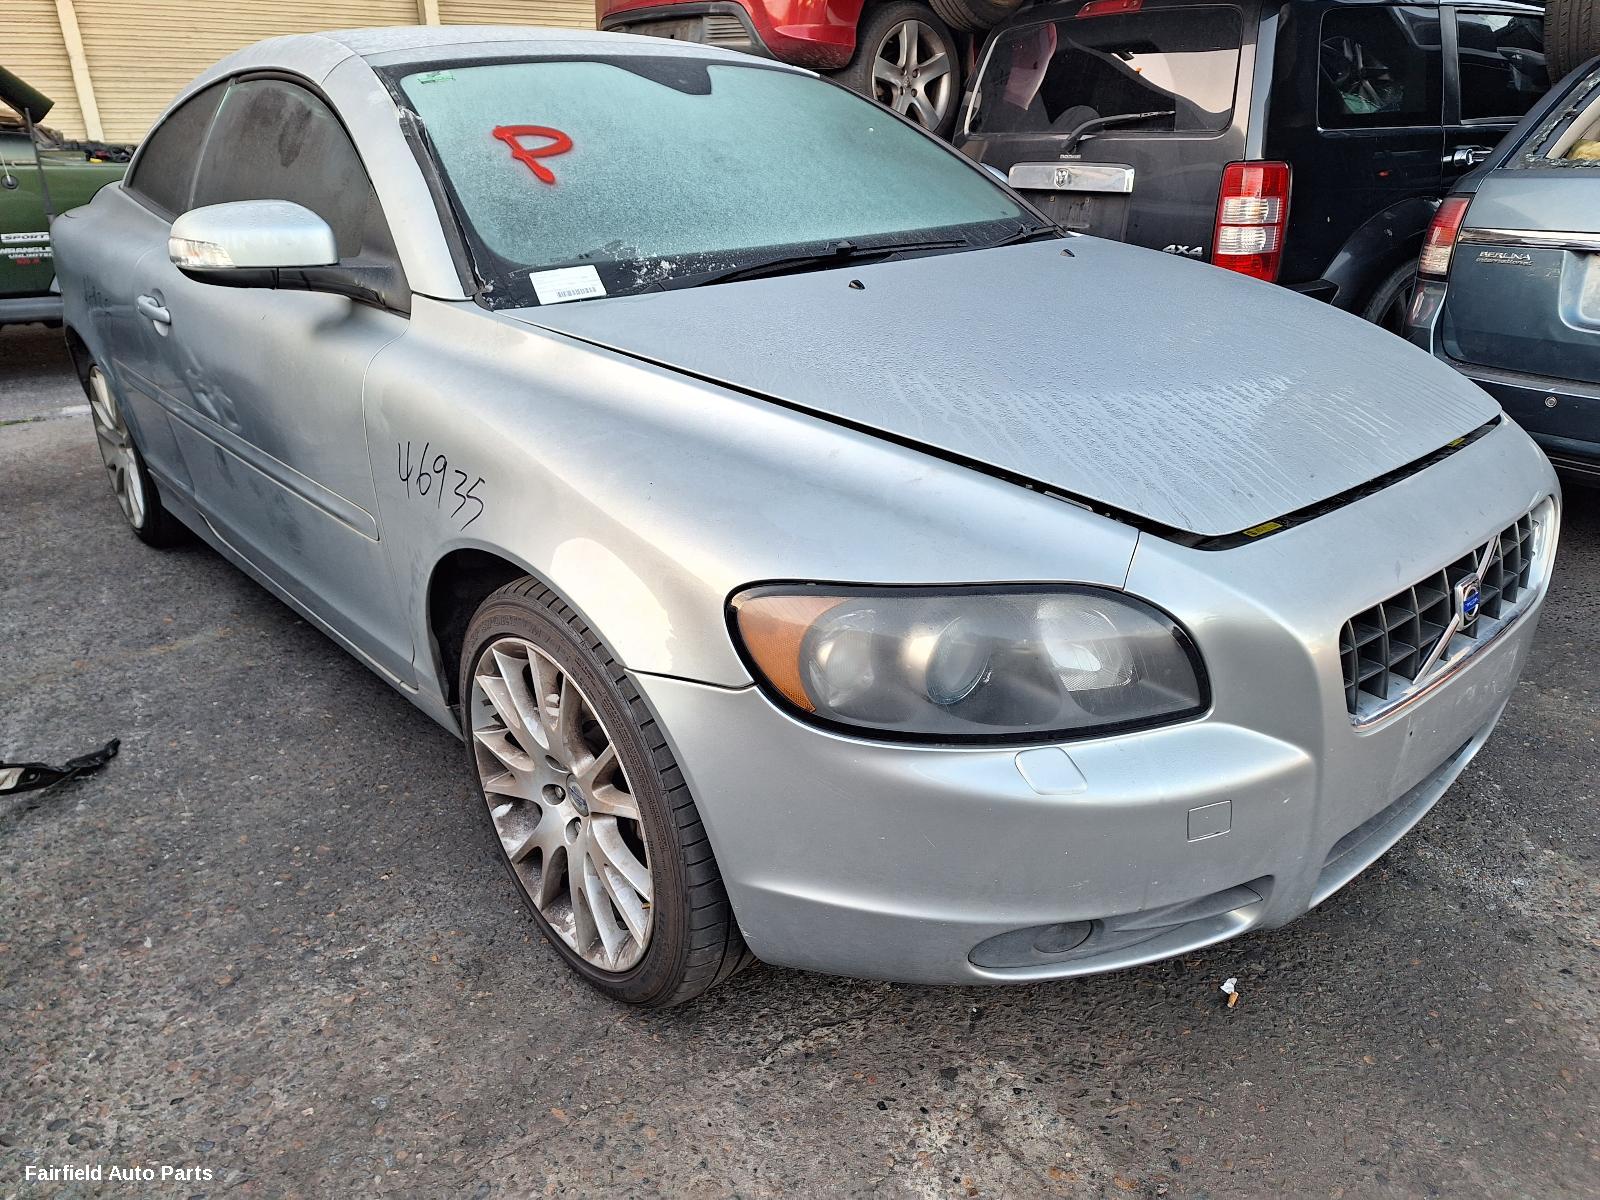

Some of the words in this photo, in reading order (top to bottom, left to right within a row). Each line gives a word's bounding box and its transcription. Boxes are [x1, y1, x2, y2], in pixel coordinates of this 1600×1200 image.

[492, 124, 573, 185] P
[0, 246, 52, 255] WRANGLE
[1479, 251, 1531, 261] BERLINA
[398, 441, 486, 532] 46935
